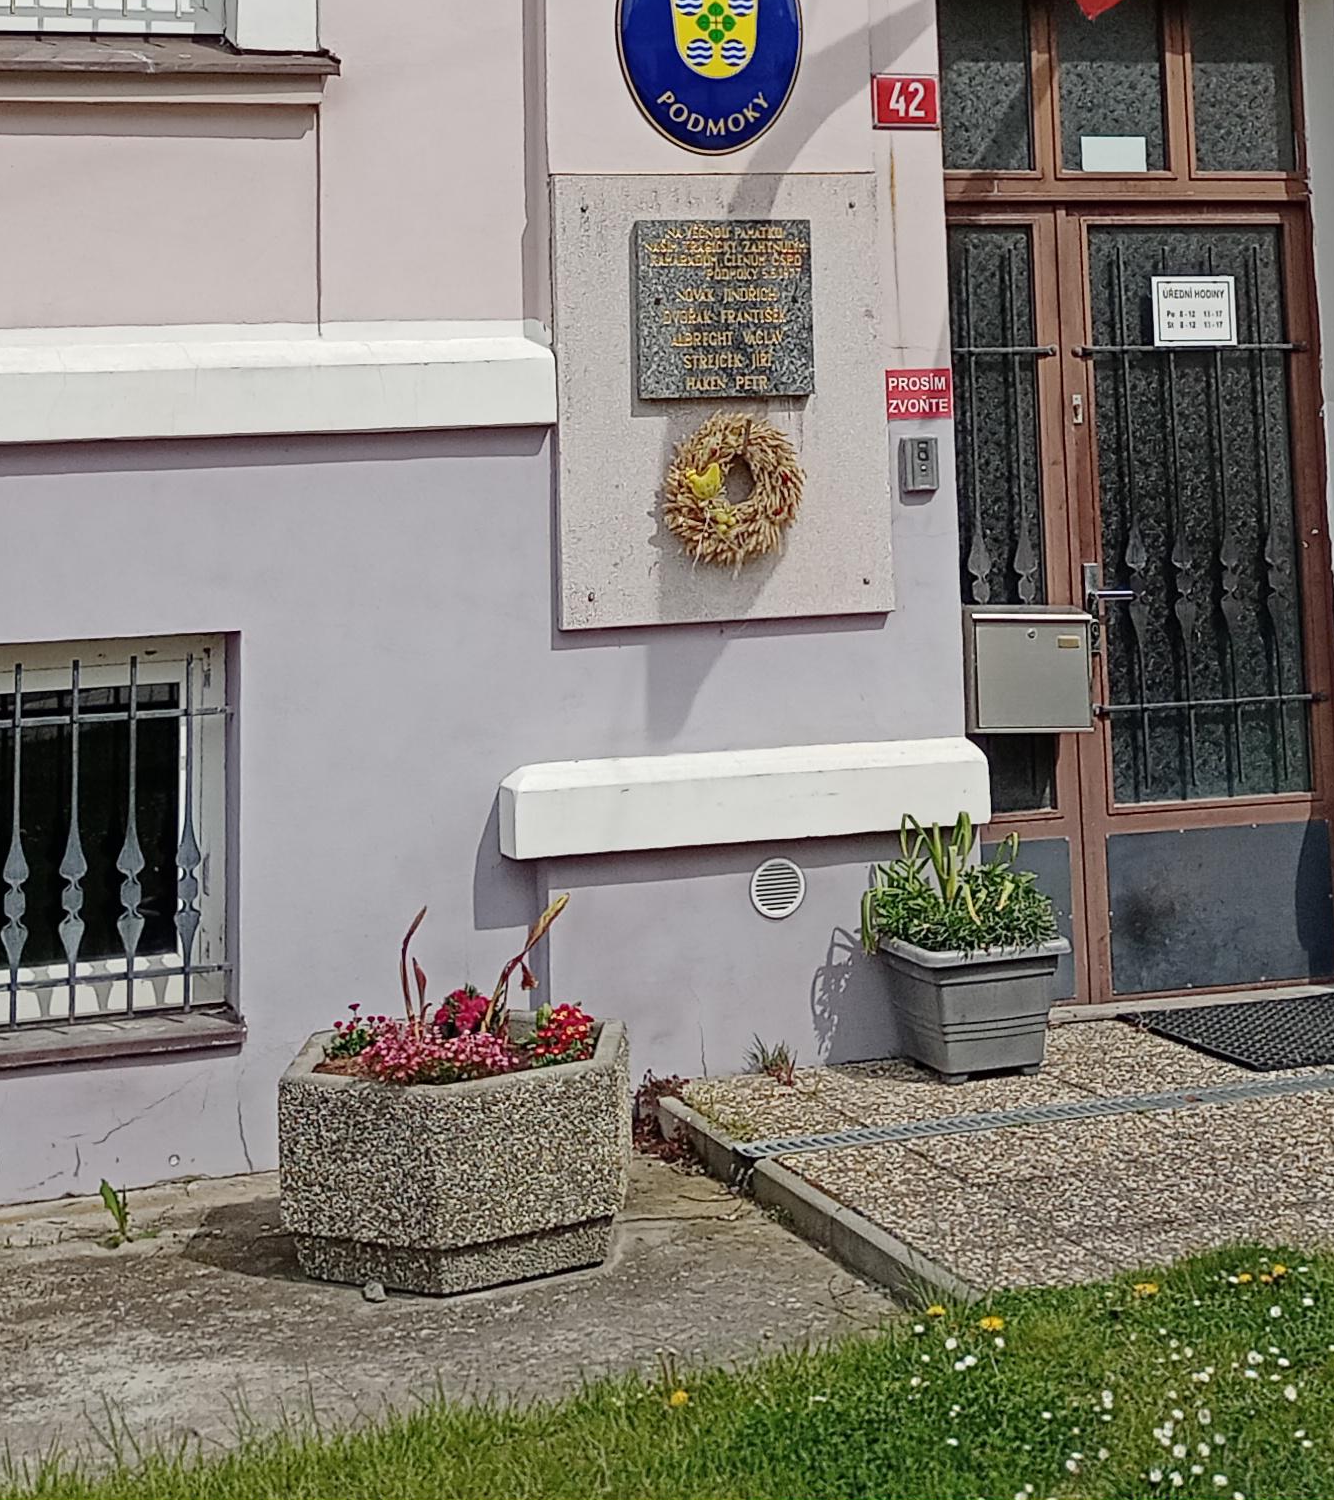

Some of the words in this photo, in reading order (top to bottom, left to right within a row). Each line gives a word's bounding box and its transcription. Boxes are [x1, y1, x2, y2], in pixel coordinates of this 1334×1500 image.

[889, 82, 926, 117] 42
[656, 91, 769, 136] PODMOKY
[665, 227, 684, 239] NA
[705, 268, 759, 281] PODMOKY
[1162, 286, 1193, 299] ÚŘEDNÍ
[1194, 289, 1225, 299] HODINY
[721, 307, 787, 324] FRANTIŠEK
[735, 375, 768, 390] PETR
[888, 373, 946, 391] PROSÍM
[888, 395, 949, 413] ZVOŇTE
